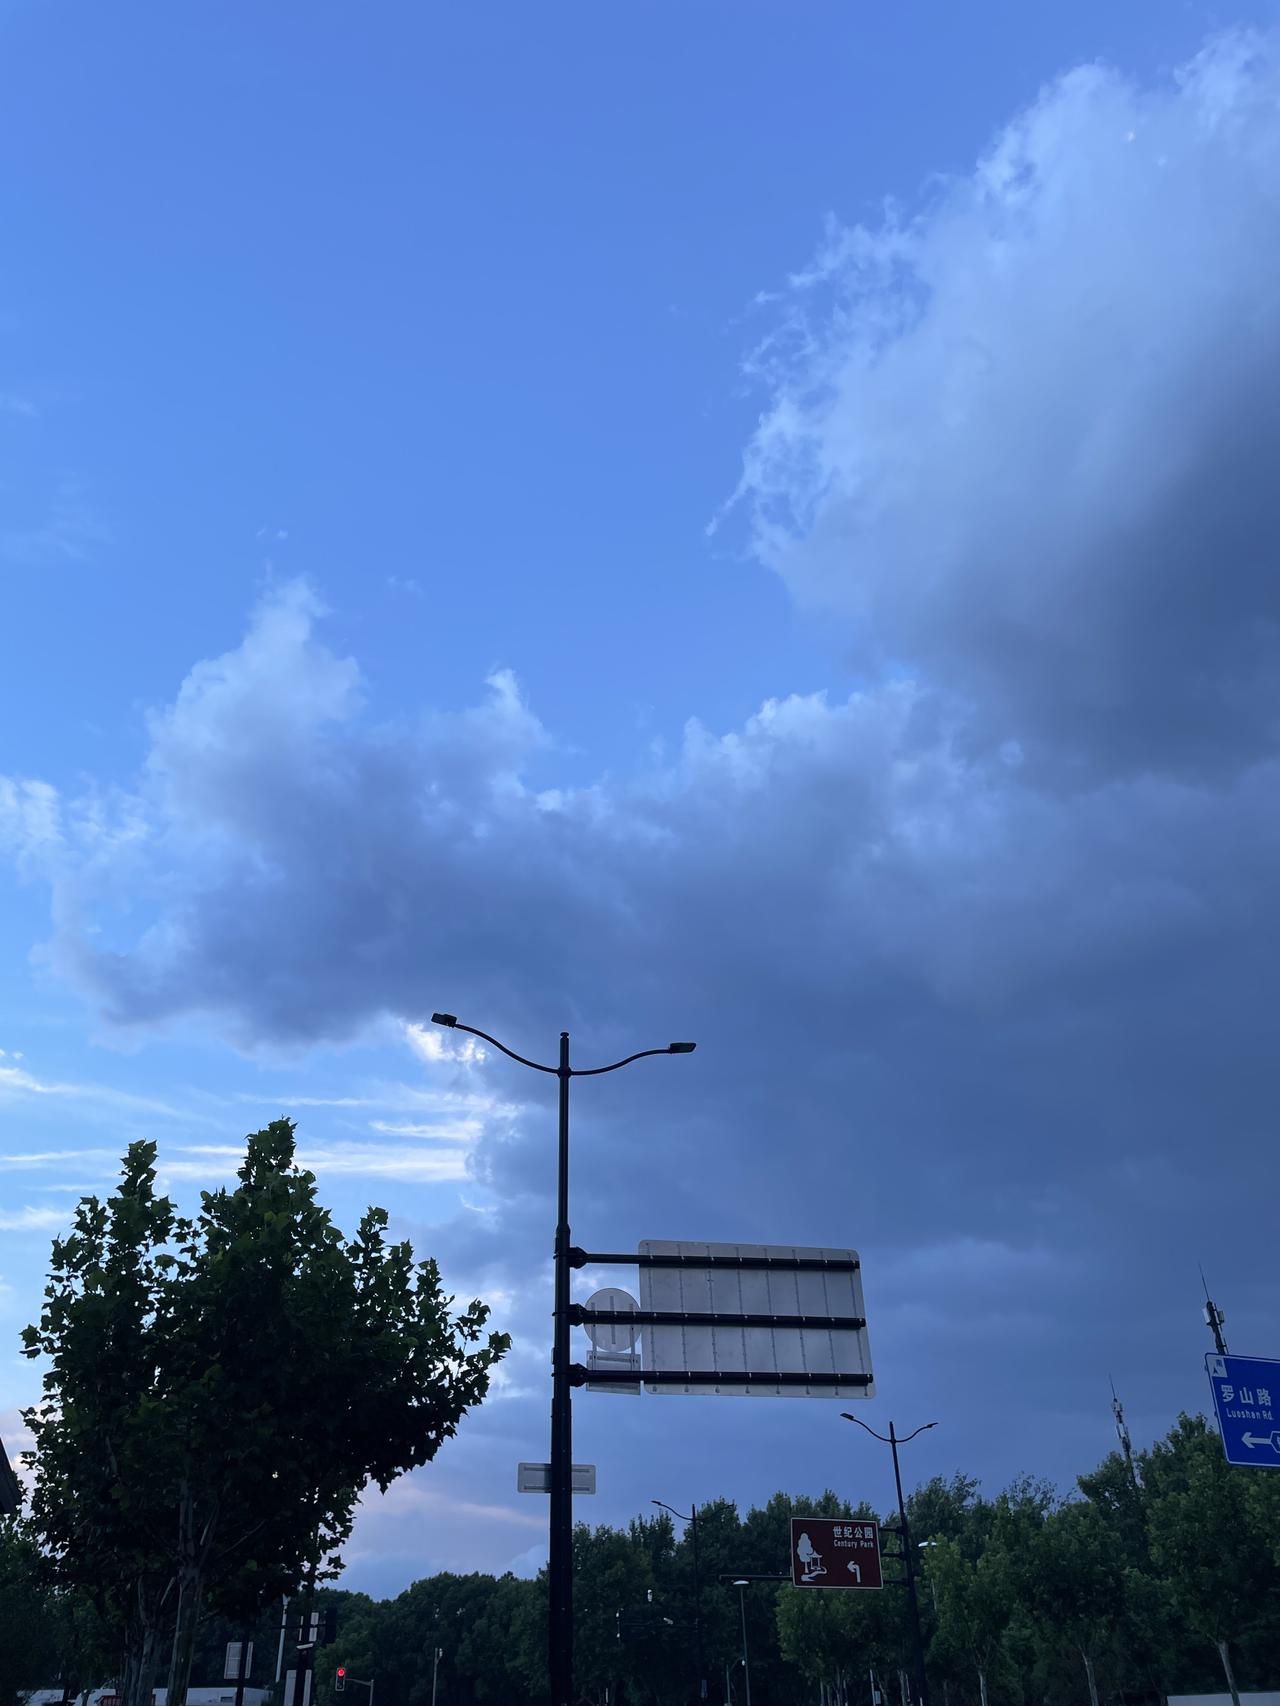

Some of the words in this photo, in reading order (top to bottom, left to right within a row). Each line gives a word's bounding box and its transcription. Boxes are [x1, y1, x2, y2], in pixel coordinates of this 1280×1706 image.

[1221, 1384, 1271, 1406] 罗山路
[1226, 1408, 1260, 1420] Luoshan
[833, 1526, 873, 1538] 世纪公园
[833, 1540, 858, 1549] Century
[860, 1540, 874, 1548] Park
